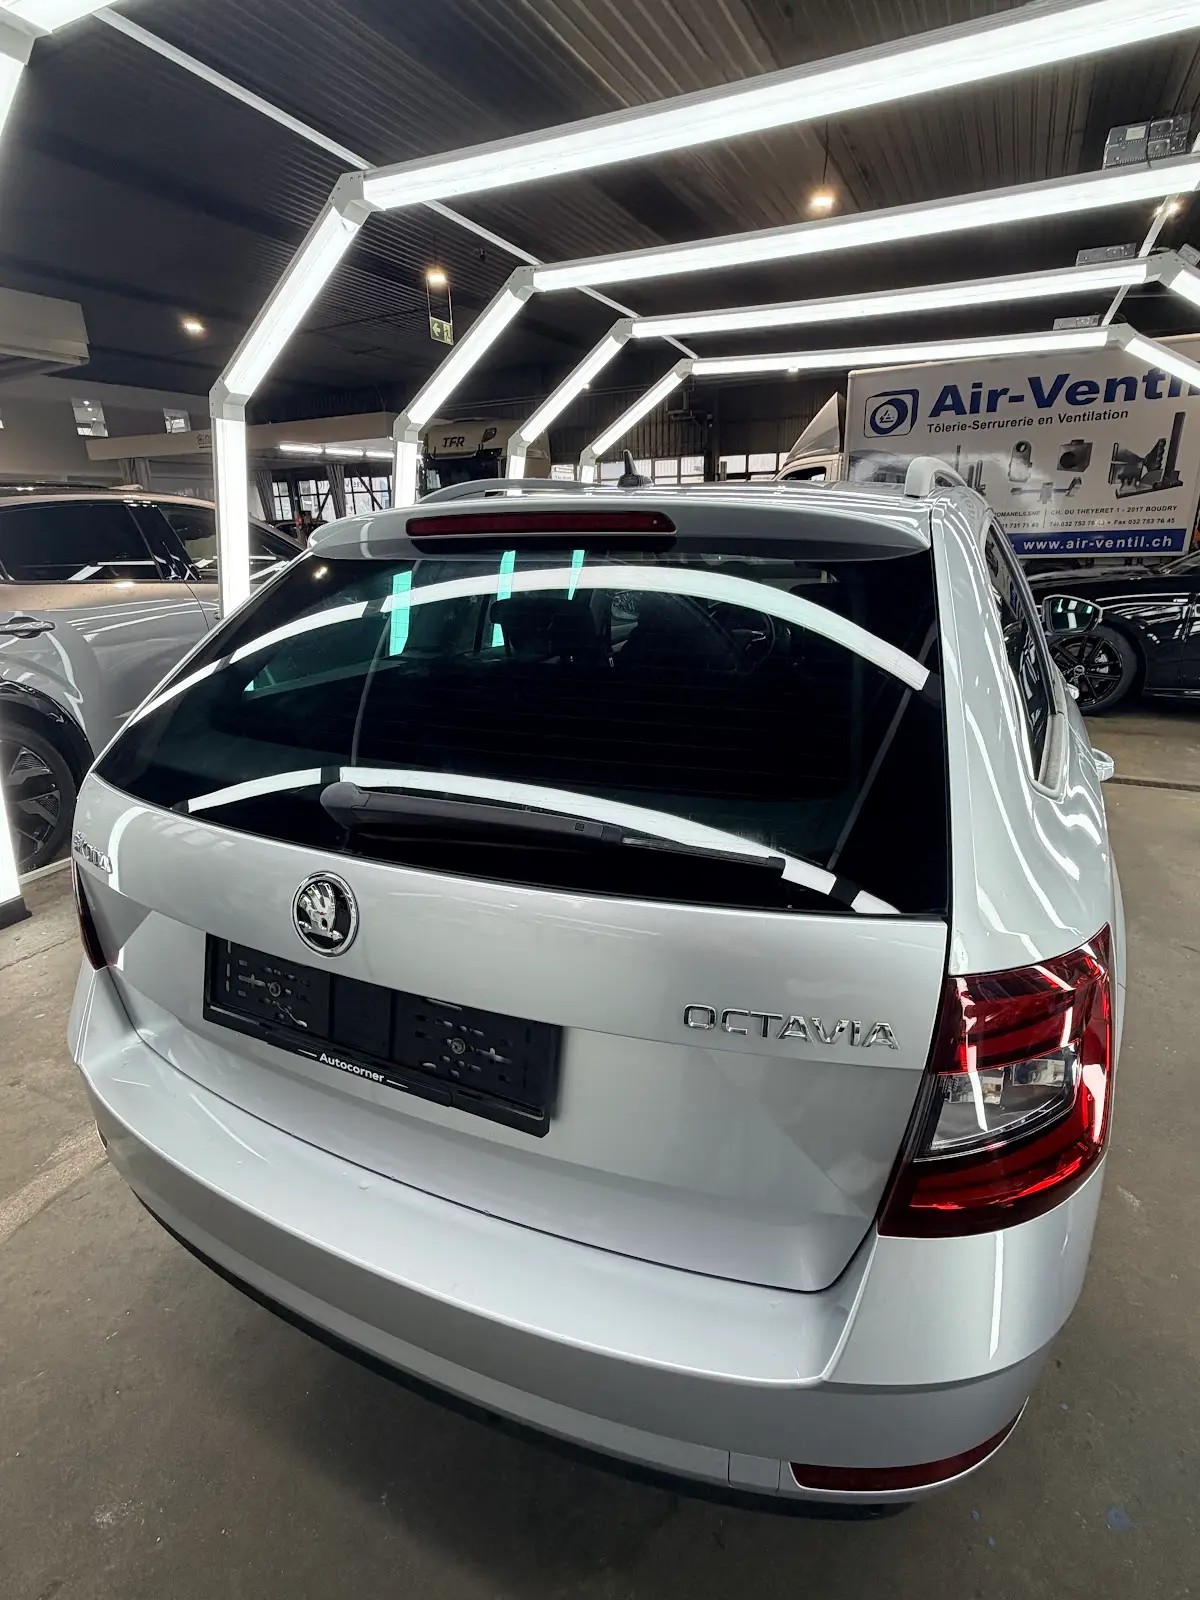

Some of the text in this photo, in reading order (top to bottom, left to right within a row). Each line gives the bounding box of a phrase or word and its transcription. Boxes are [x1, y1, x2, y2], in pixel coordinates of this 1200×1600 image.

[928, 366, 1200, 418] Air-Venti
[926, 409, 1129, 434] Tôlerie-Serrurerie en Ventilation
[442, 436, 465, 448] TFR
[1076, 507, 1114, 515] THEYERET
[1023, 535, 1172, 550] www.air-ventil.ch
[683, 1003, 901, 1050] OCTAVIA
[319, 1052, 385, 1082] Autocorner
